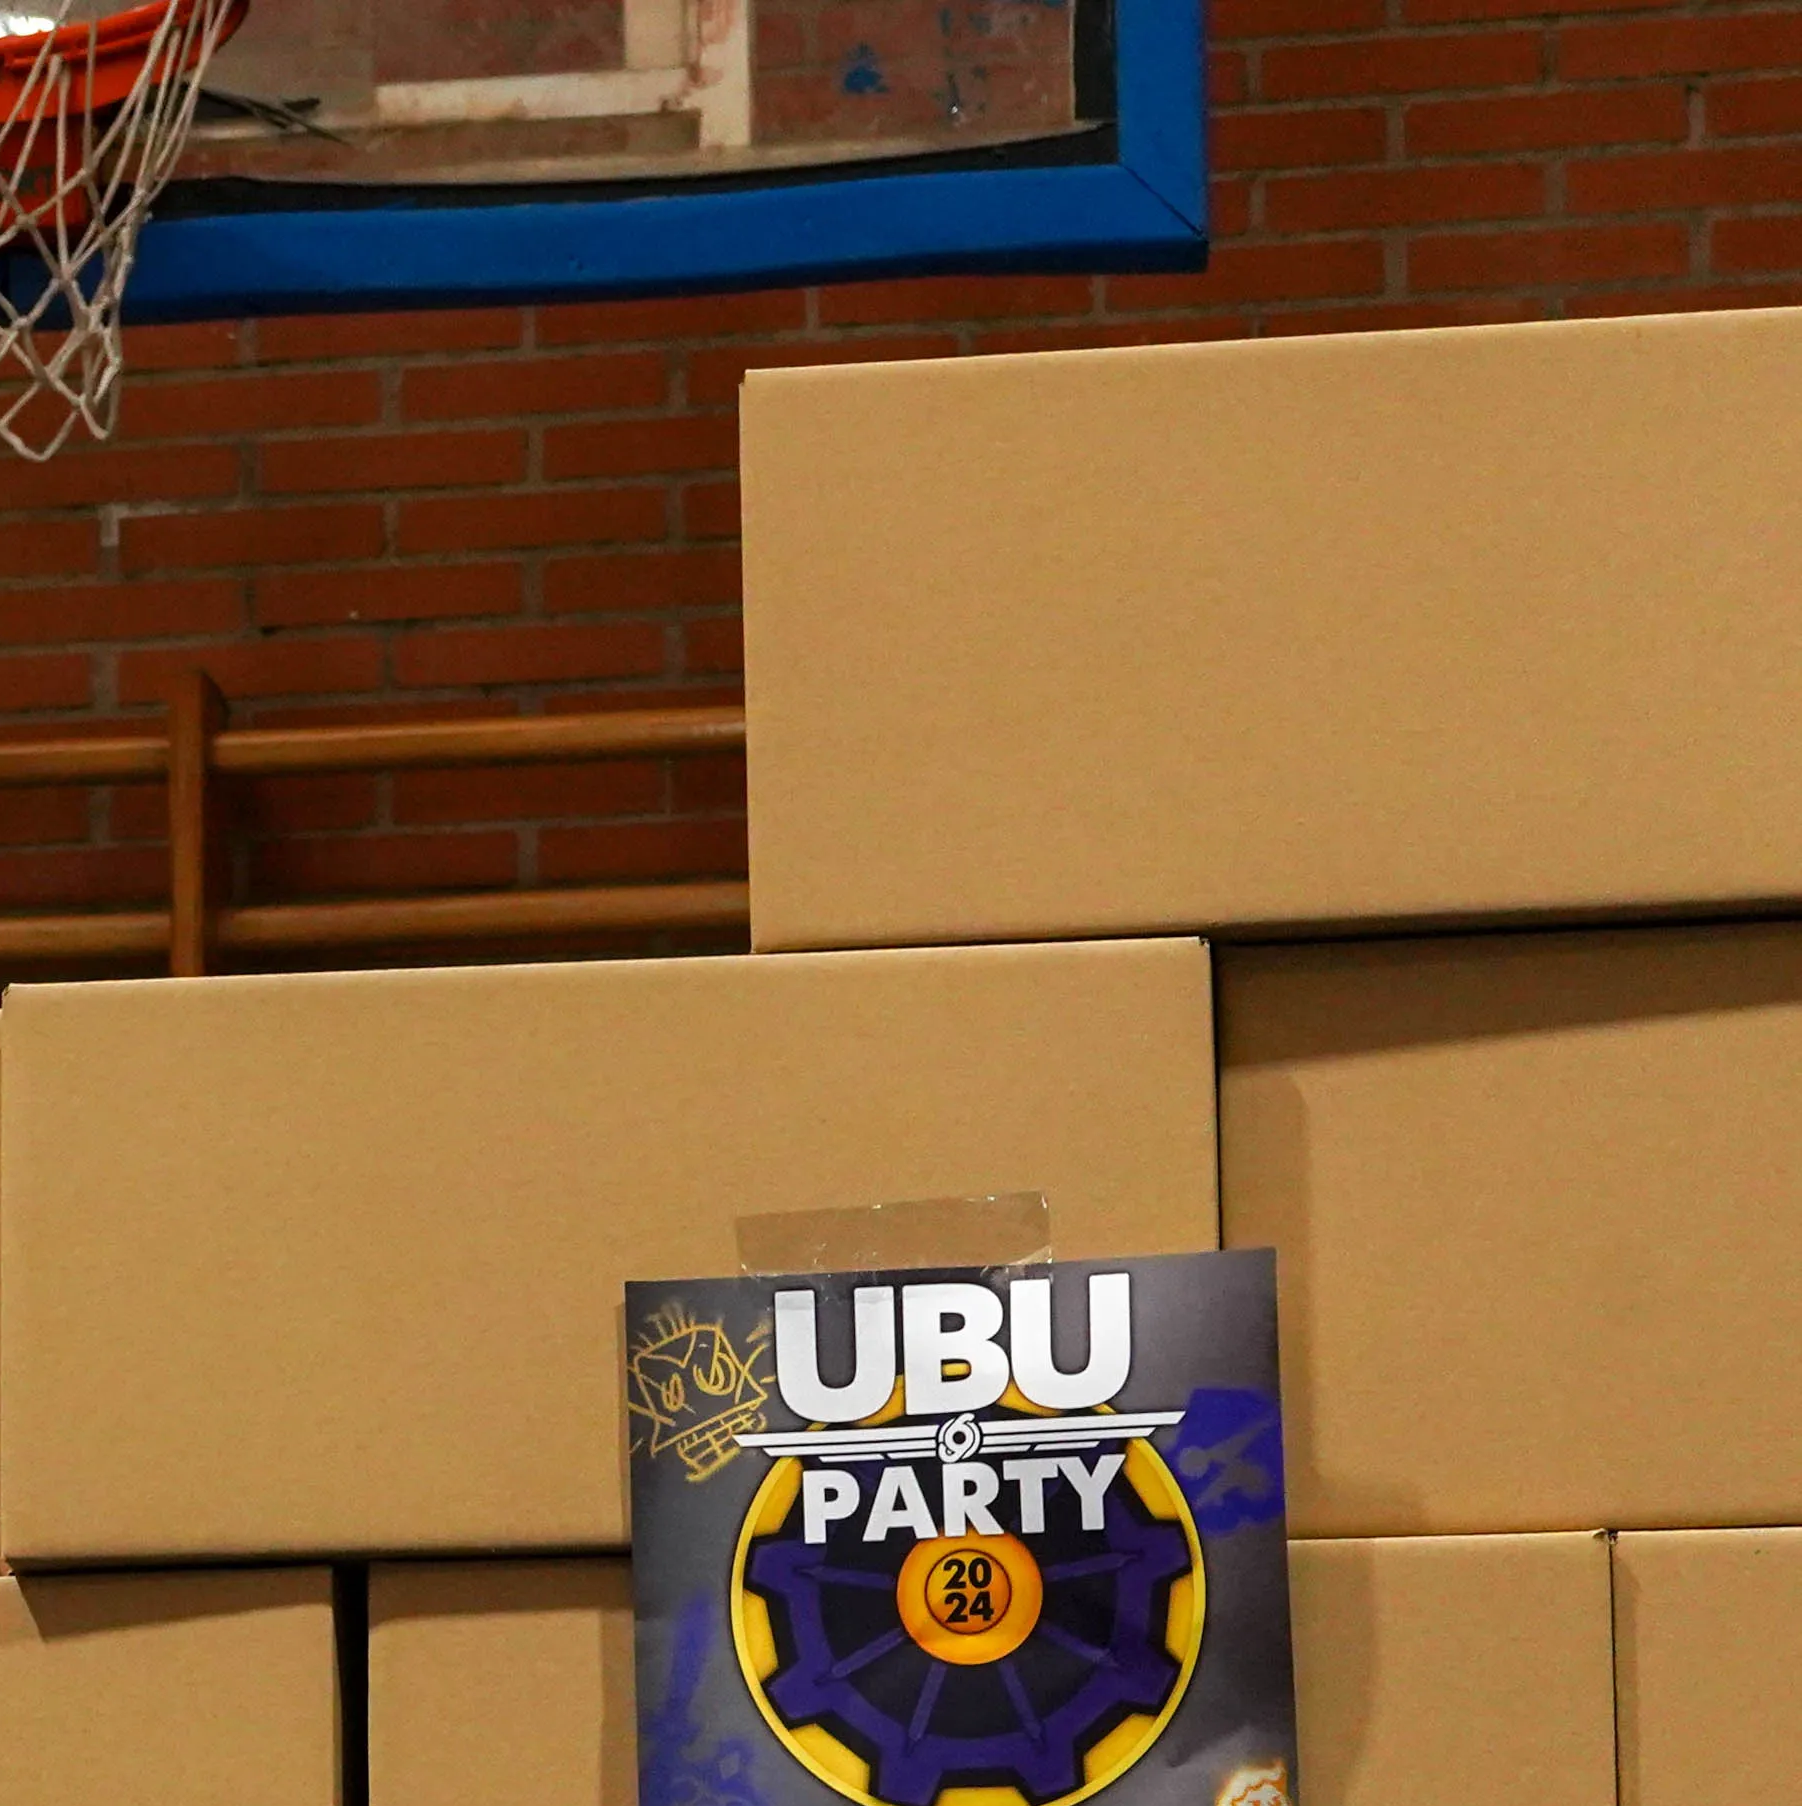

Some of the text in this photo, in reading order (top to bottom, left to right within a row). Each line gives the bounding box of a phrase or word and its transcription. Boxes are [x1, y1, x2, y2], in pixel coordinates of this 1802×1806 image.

[774, 1273, 1131, 1423] UBU
[802, 1453, 1127, 1545] PARTY
[943, 1557, 992, 1590] 20
[943, 1590, 994, 1623] 24
